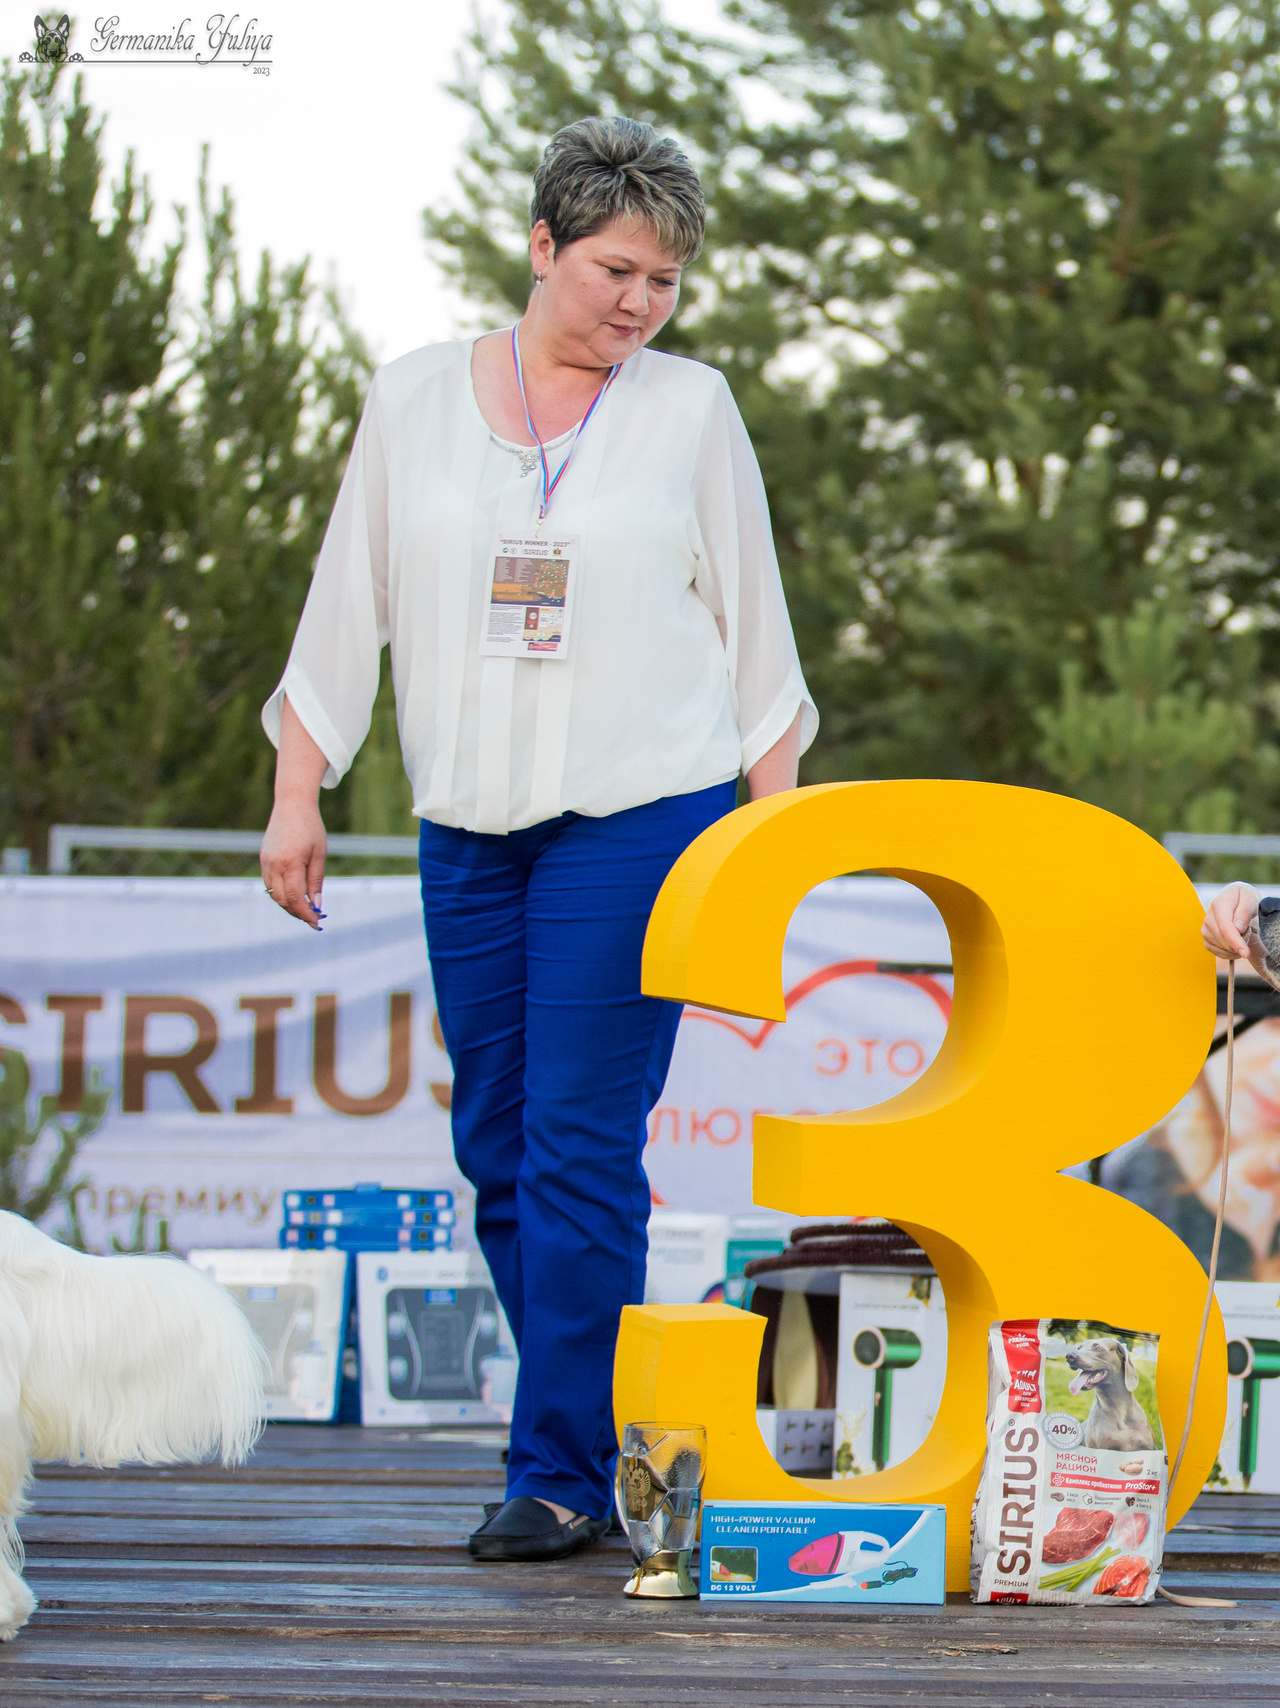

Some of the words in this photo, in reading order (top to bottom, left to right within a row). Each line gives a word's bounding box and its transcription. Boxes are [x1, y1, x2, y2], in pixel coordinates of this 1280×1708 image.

[814, 1037, 926, 1078] ЭТО
[613, 779, 1228, 1593] 3
[1013, 1379, 1037, 1392] ADULT
[1052, 1424, 1077, 1435] 40%
[1056, 1453, 1098, 1464] МЯСНОЙ
[1056, 1462, 1097, 1473] РАЦИОН
[1066, 1477, 1091, 1486] Комплекс
[1091, 1480, 1122, 1490] пробиотиков
[1125, 1482, 1156, 1491] ProStor+
[996, 1427, 1039, 1575] SIRIUS
[710, 1515, 773, 1524] HIGH-POWER
[775, 1516, 816, 1524] VACUUM
[716, 1525, 759, 1533] CLEANER
[760, 1526, 809, 1534] PORTABLE
[994, 1578, 1029, 1587] PREMIUM
[995, 1595, 1022, 1604] ADULT
